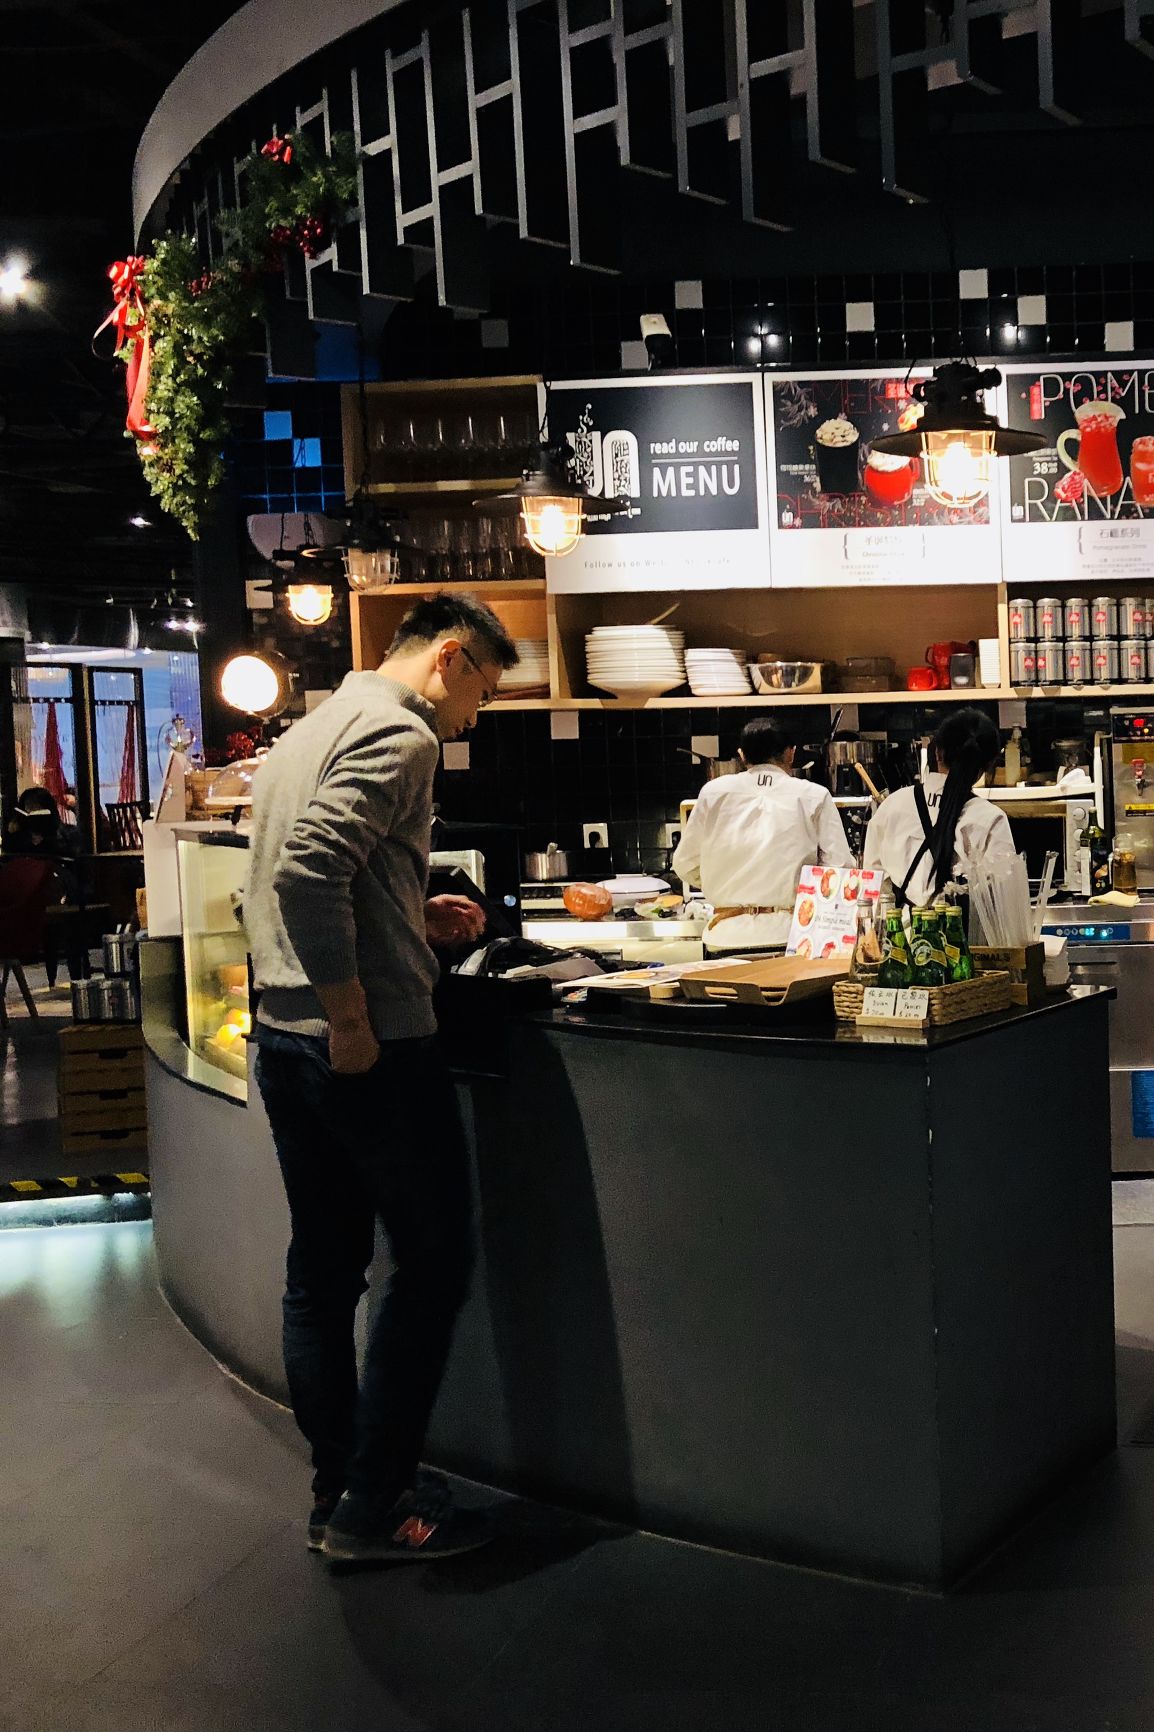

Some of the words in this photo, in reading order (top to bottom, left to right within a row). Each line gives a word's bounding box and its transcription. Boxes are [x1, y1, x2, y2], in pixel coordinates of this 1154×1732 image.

[650, 438, 676, 454] read
[678, 440, 698, 453] our
[703, 436, 740, 452] coffee
[652, 464, 741, 498] MENU
[584, 560, 613, 569] Follow
